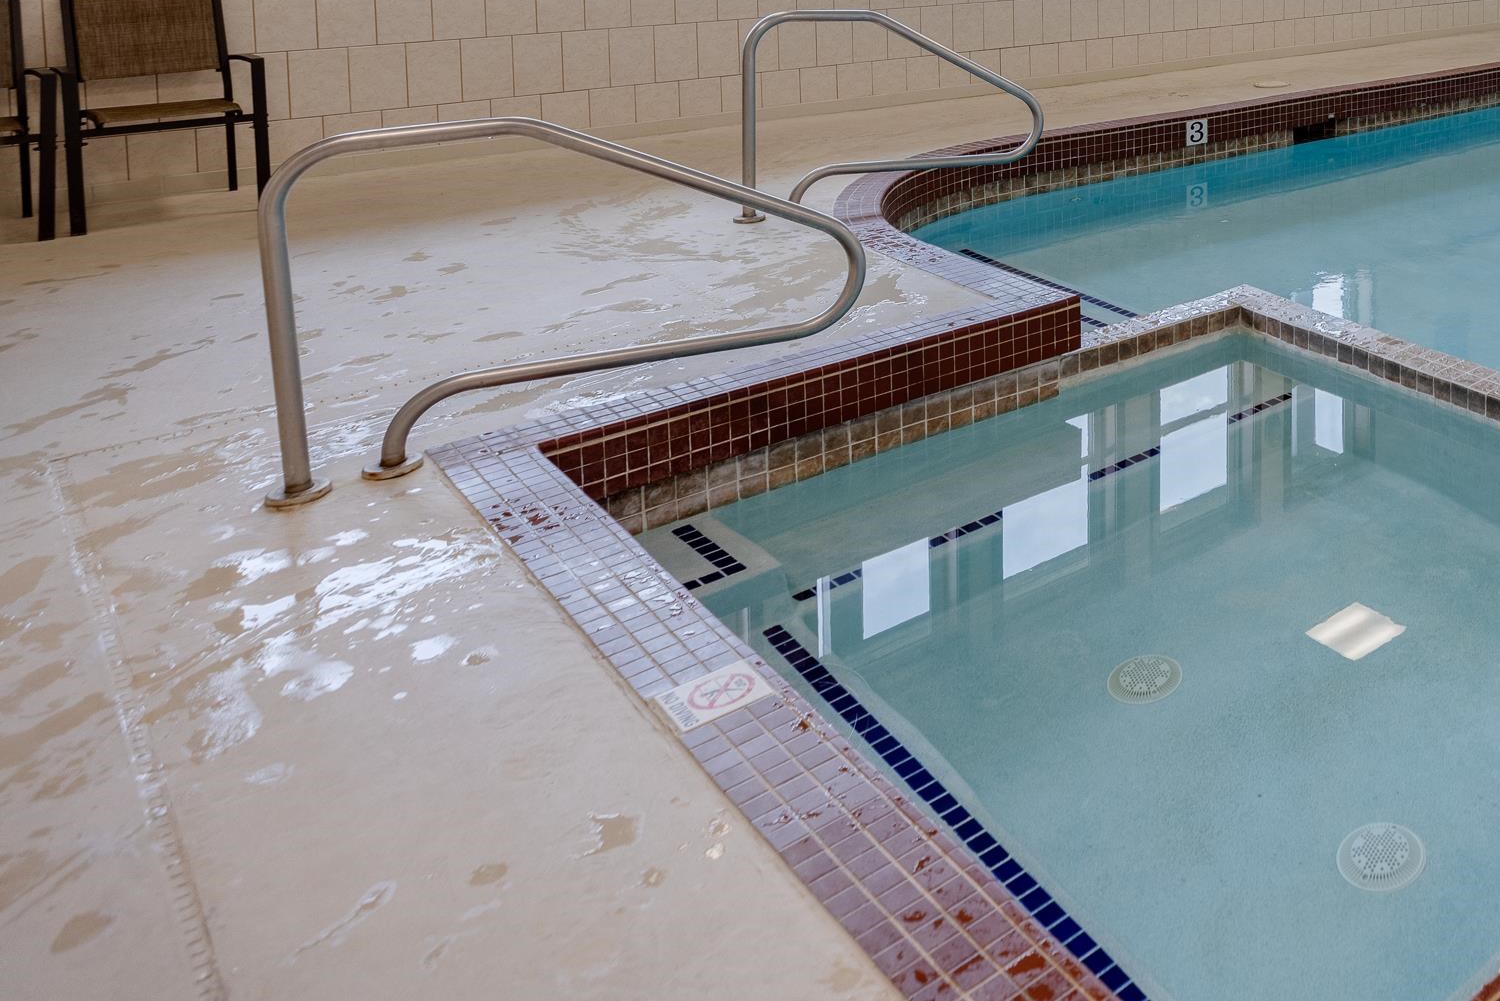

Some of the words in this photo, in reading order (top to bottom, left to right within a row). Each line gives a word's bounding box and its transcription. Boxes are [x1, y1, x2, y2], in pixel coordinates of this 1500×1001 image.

[1190, 121, 1204, 143] 3
[660, 691, 680, 705] NO
[669, 702, 700, 728] DIVING
